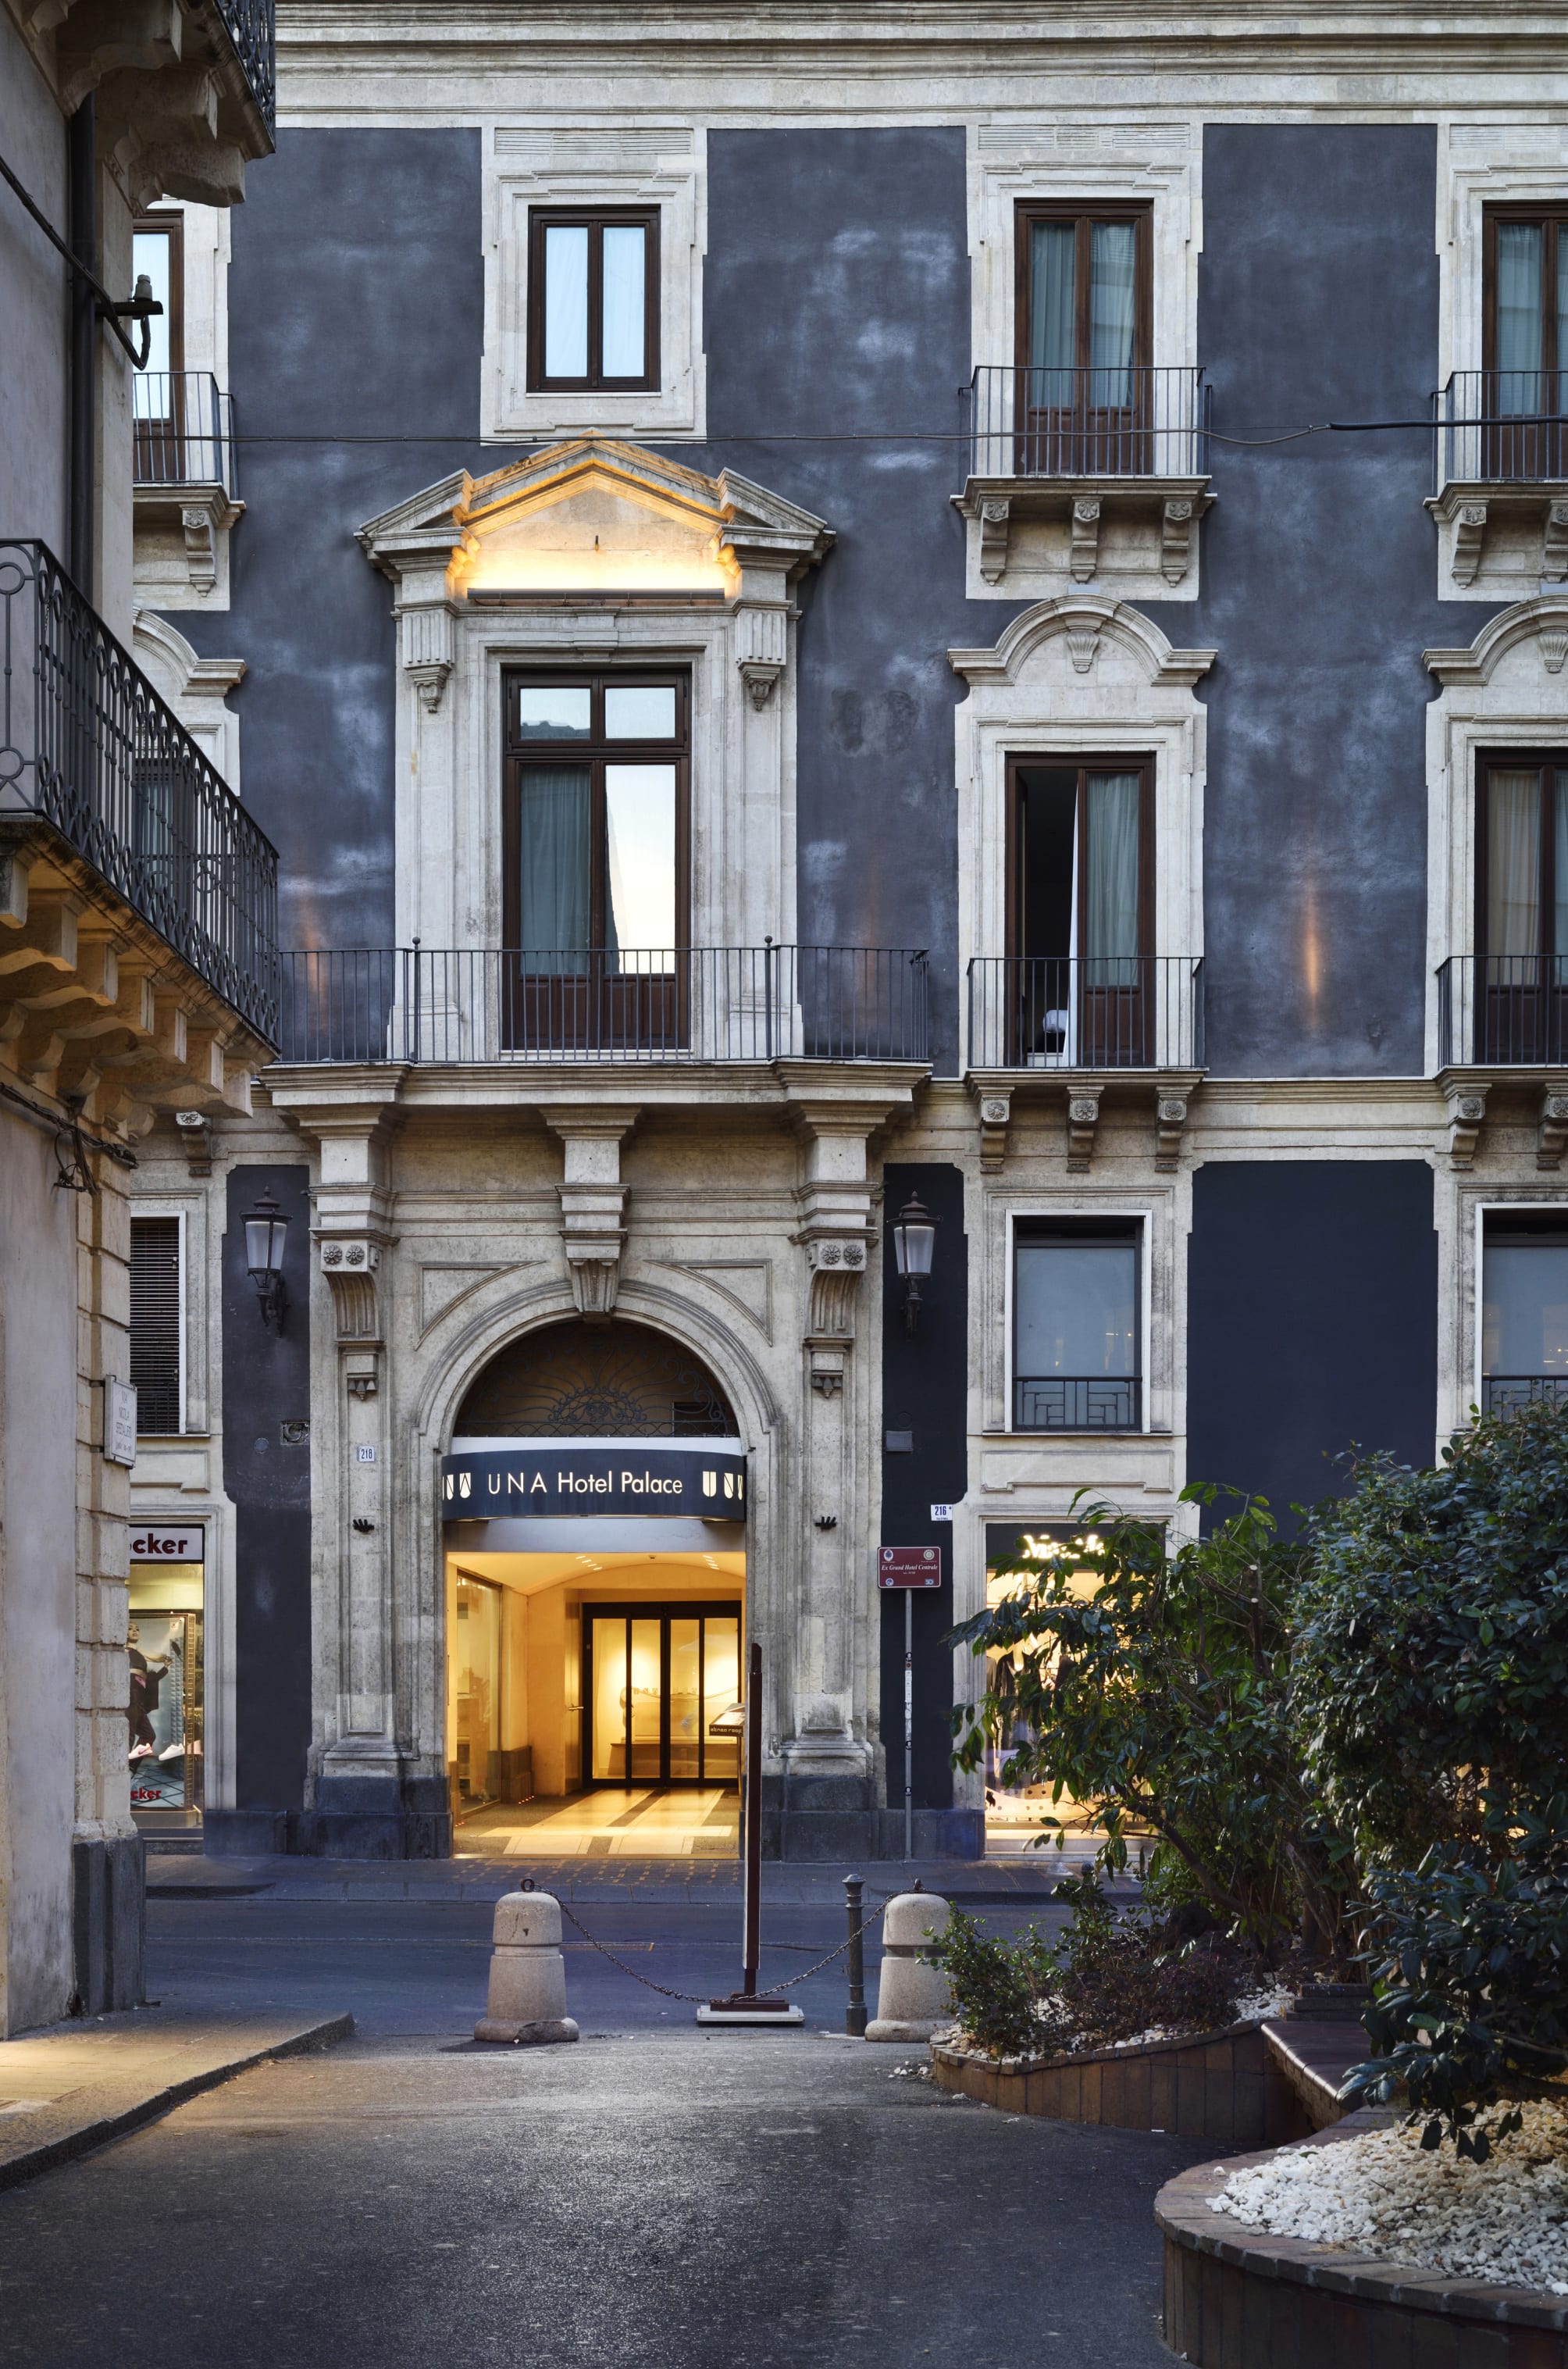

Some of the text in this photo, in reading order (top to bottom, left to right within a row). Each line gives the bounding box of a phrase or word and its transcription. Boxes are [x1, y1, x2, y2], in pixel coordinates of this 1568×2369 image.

[361, 1448, 372, 1459] 218
[488, 1470, 683, 1495] UNA Hotel Palace
[935, 1506, 946, 1515] 216
[130, 1533, 187, 1554] cker
